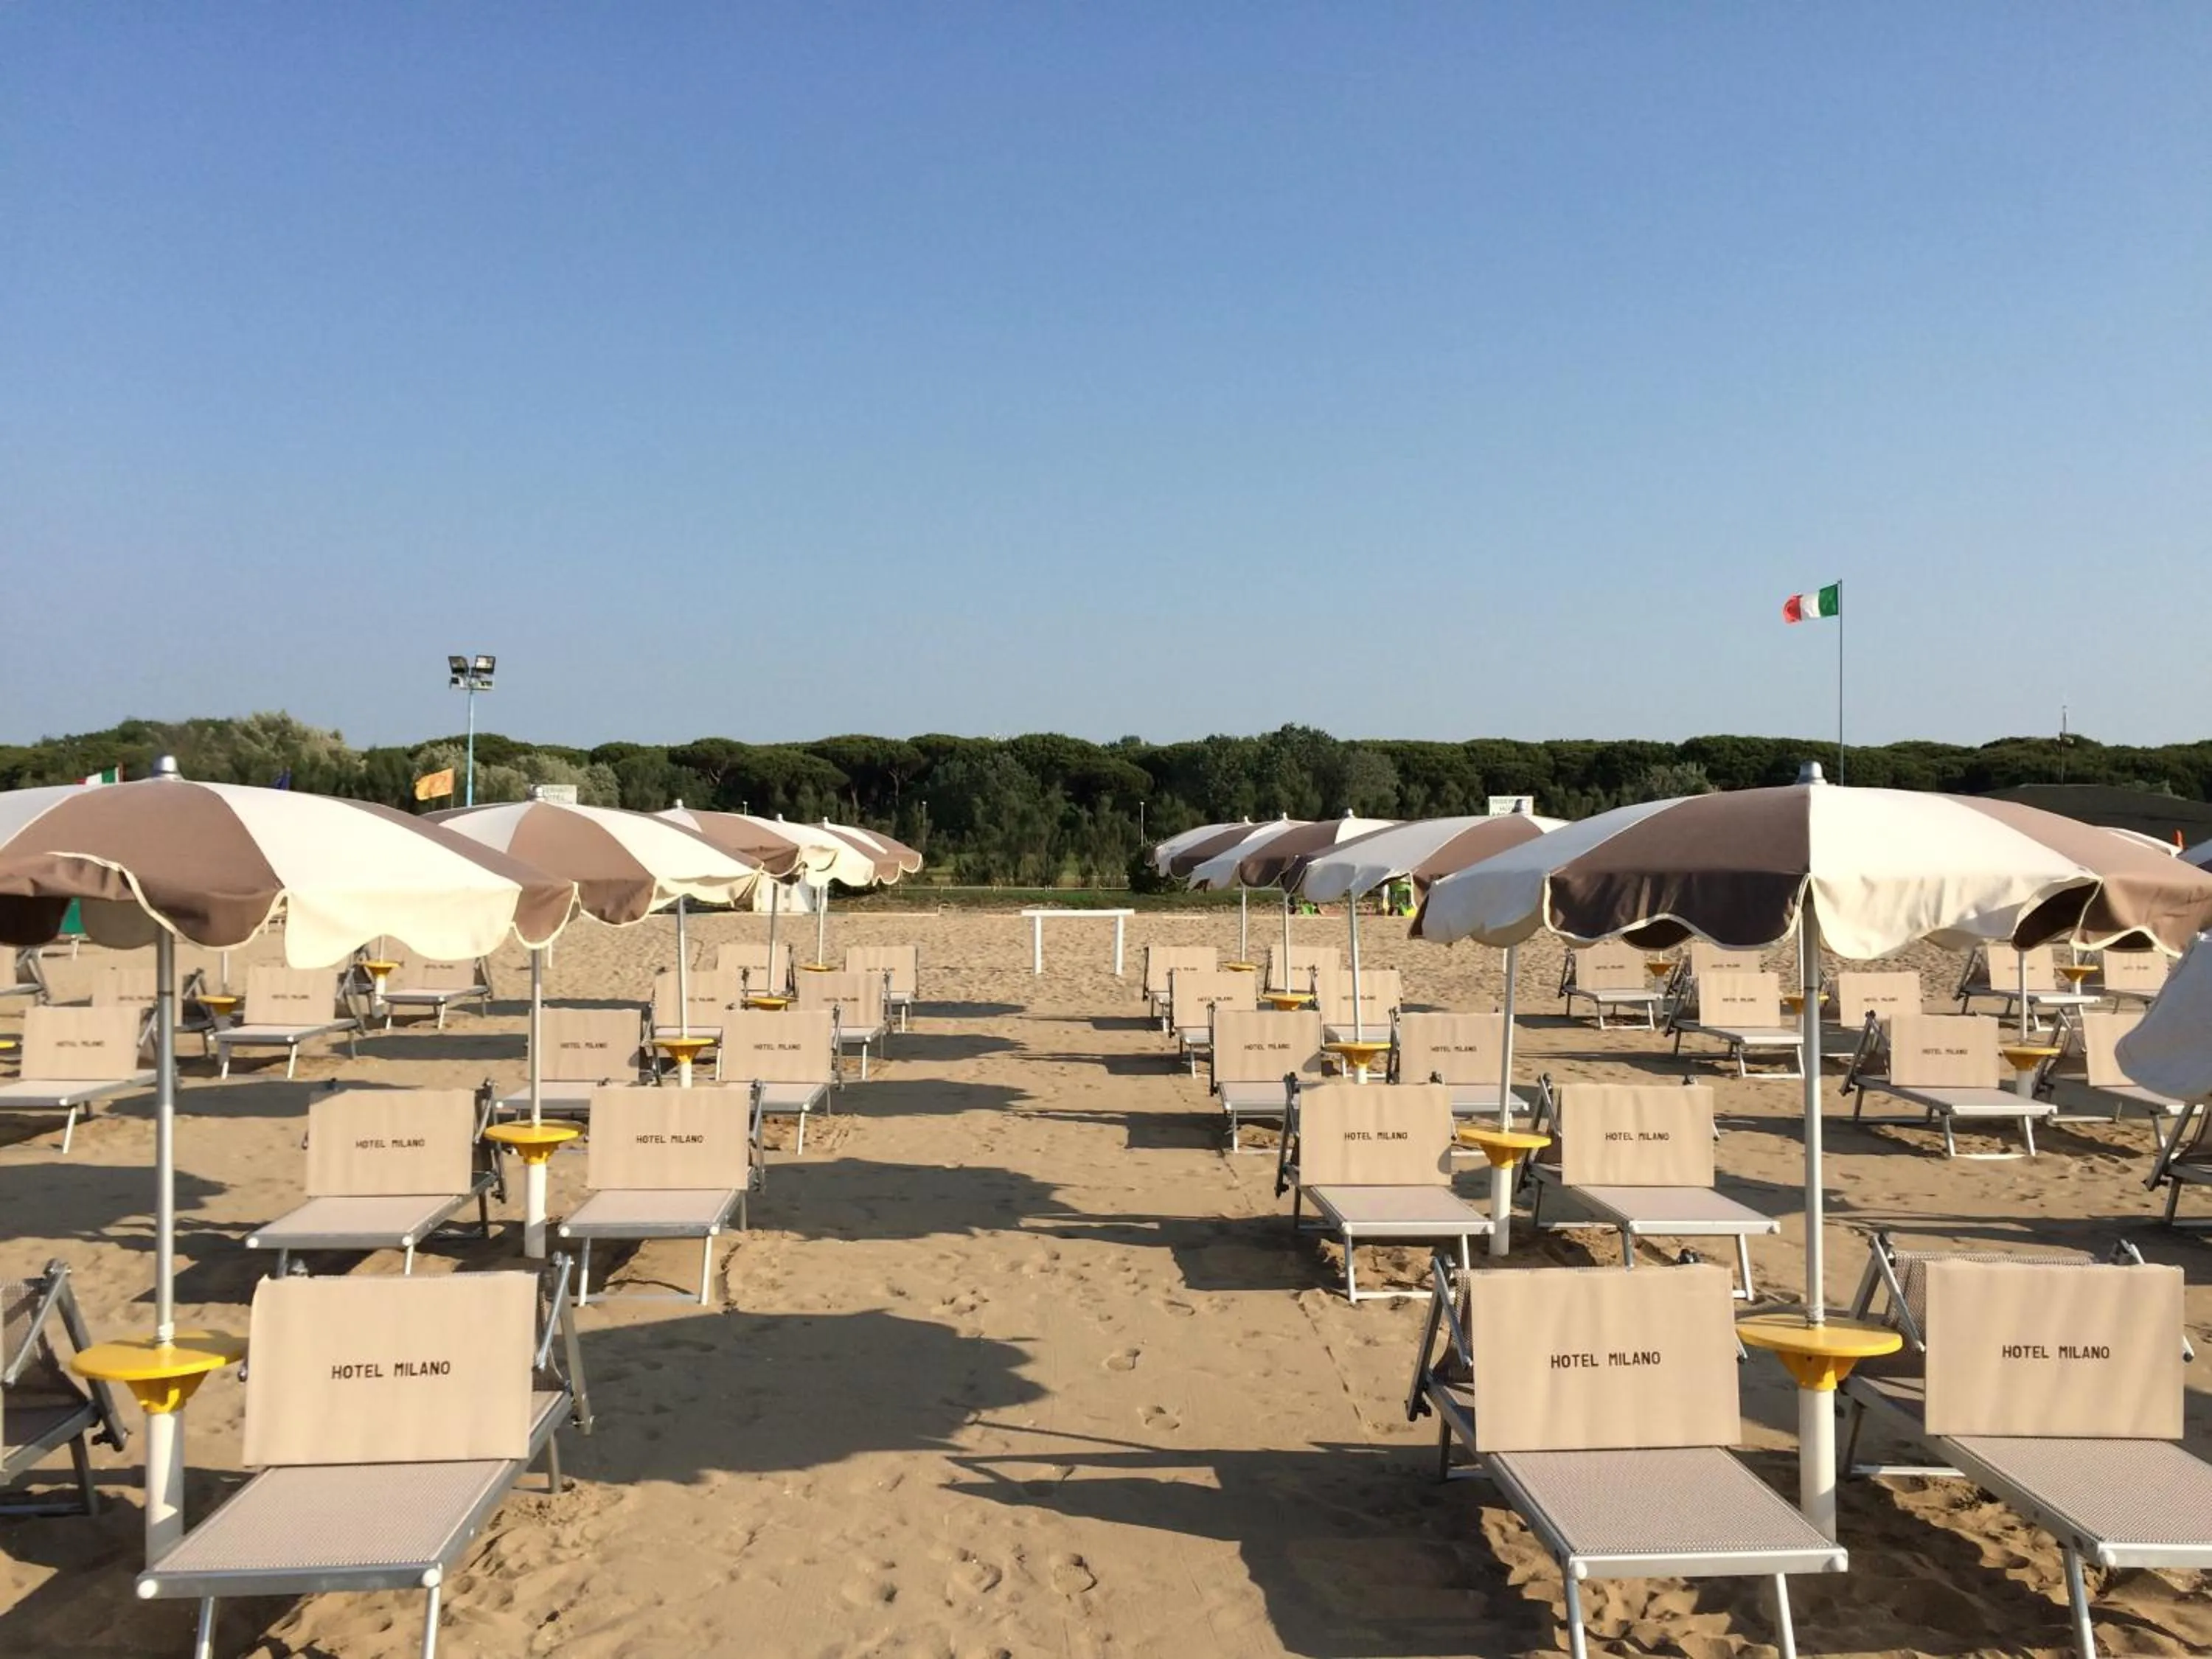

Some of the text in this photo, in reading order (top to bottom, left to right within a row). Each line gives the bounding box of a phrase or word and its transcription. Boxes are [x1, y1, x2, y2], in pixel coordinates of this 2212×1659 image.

[636, 1135, 704, 1144] HOTEL MILANO
[2002, 1345, 2110, 1359] HOTEL MILANO
[1551, 1352, 1660, 1368] HOTEL MILANO
[331, 1360, 451, 1380] HOTEL MILANO
